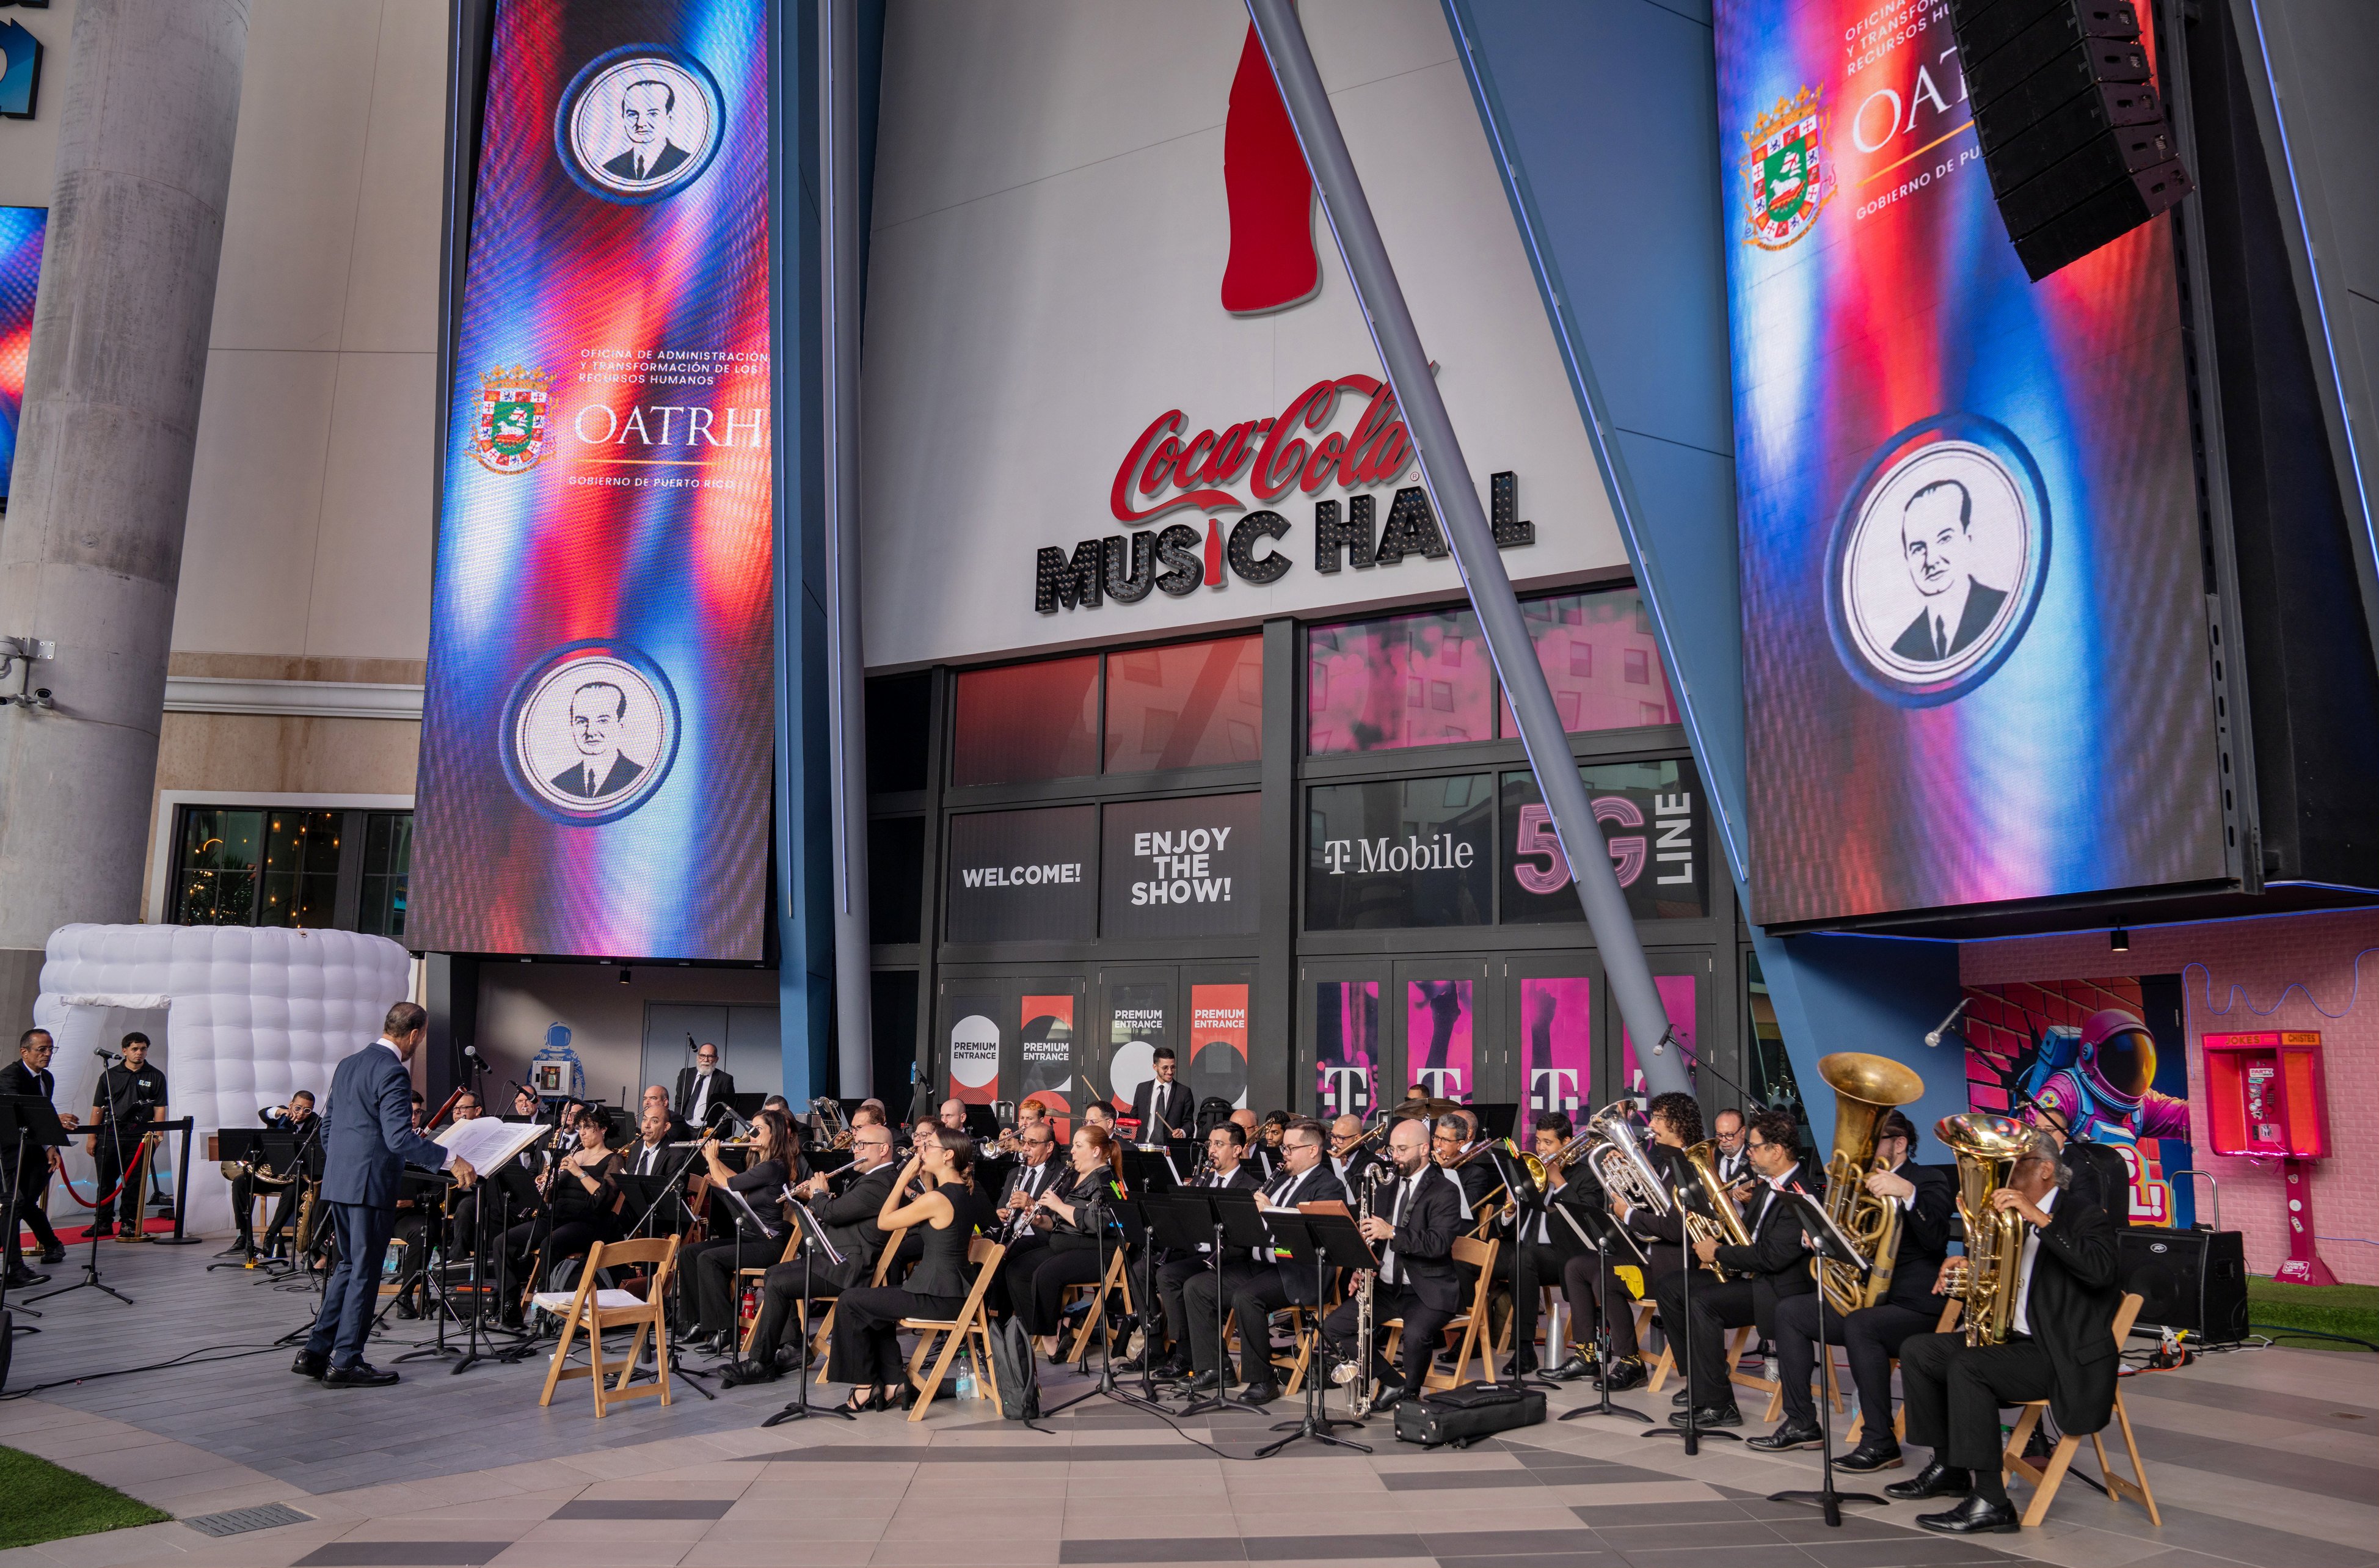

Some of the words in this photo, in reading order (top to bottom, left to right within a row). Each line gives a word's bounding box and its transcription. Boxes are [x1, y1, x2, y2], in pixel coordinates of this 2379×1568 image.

[1847, 45, 1854, 57] Y
[1848, 18, 1926, 76] RECURSOS
[1856, 173, 1931, 220] GOBIERNO
[1936, 159, 1954, 179] DE
[581, 349, 632, 359] OFICINA
[638, 350, 652, 359] DE
[657, 351, 768, 362] ADMINISTRACIÓN
[580, 361, 586, 370] Y
[592, 361, 710, 373] TRANSFORMACIÓN
[715, 364, 729, 373] DE
[735, 365, 757, 374] LOS
[578, 373, 646, 383] RECURSOS
[650, 374, 713, 385] HUMANOS
[575, 404, 763, 448] OATRH
[1110, 373, 1417, 527] Coca-Cola
[569, 476, 630, 486] GOBIERNO
[635, 478, 649, 487] DE
[654, 478, 700, 489] PUERTO
[704, 480, 734, 489] RICO
[1314, 470, 1536, 574] HAL
[1134, 827, 1231, 856] ENJOY
[1655, 792, 1693, 884] LINE
[1515, 797, 1647, 894] 5G
[1357, 833, 1474, 873] Mobile
[1153, 853, 1209, 880] THE
[963, 863, 1081, 888] WELCOME!
[1131, 878, 1231, 906] SHOW!
[1115, 1010, 1162, 1019] PREMIUM
[1195, 1009, 1244, 1019] PREMIUM
[1194, 1019, 1245, 1028] ENTRANCE
[2225, 1035, 2260, 1045] JOKES
[2288, 1034, 2315, 1043] CHISTES
[954, 1042, 996, 1051] PREMIUM
[1024, 1042, 1069, 1052] PREMIUM
[1023, 1052, 1069, 1061] ENTRANCE
